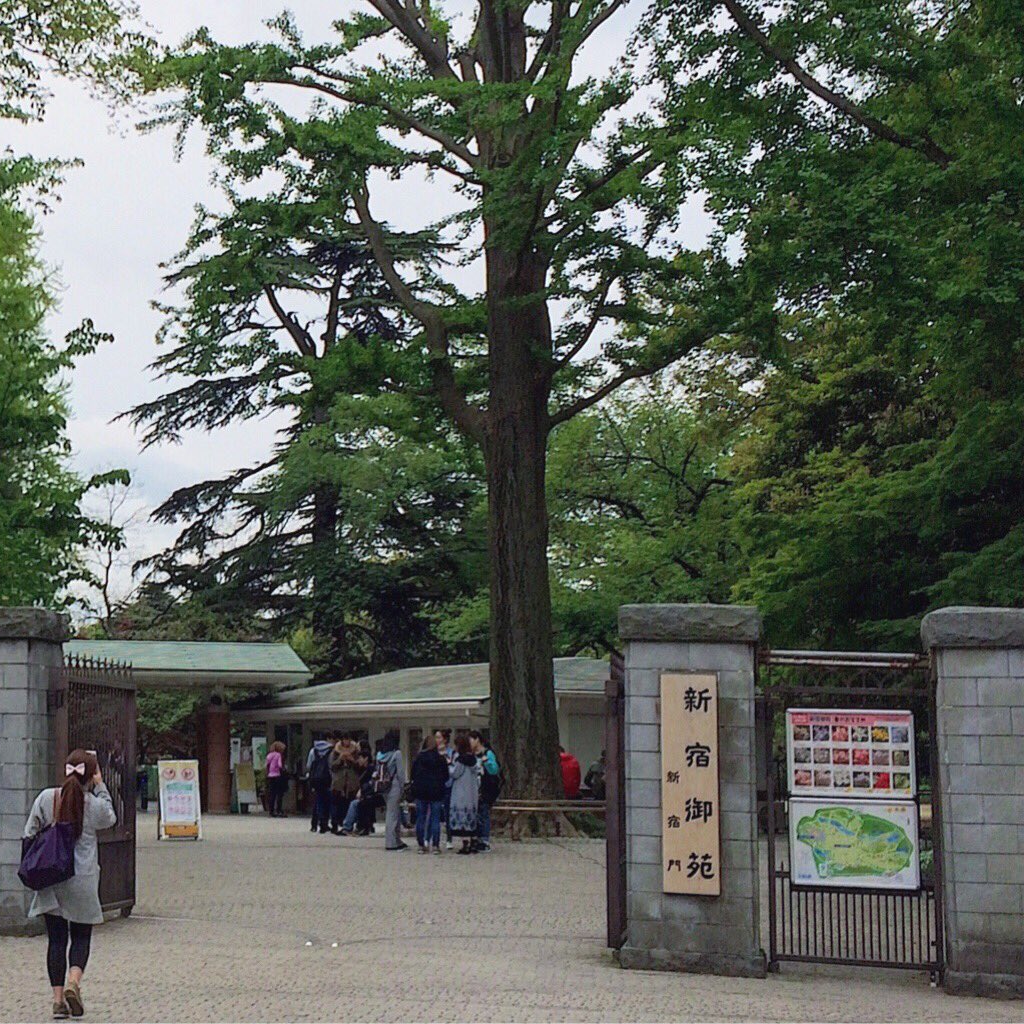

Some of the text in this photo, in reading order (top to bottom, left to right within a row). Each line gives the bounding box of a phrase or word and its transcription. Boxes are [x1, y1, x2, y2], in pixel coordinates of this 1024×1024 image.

[666, 770, 682, 873] 新宿門
[683, 686, 715, 880] 新宿御苑
